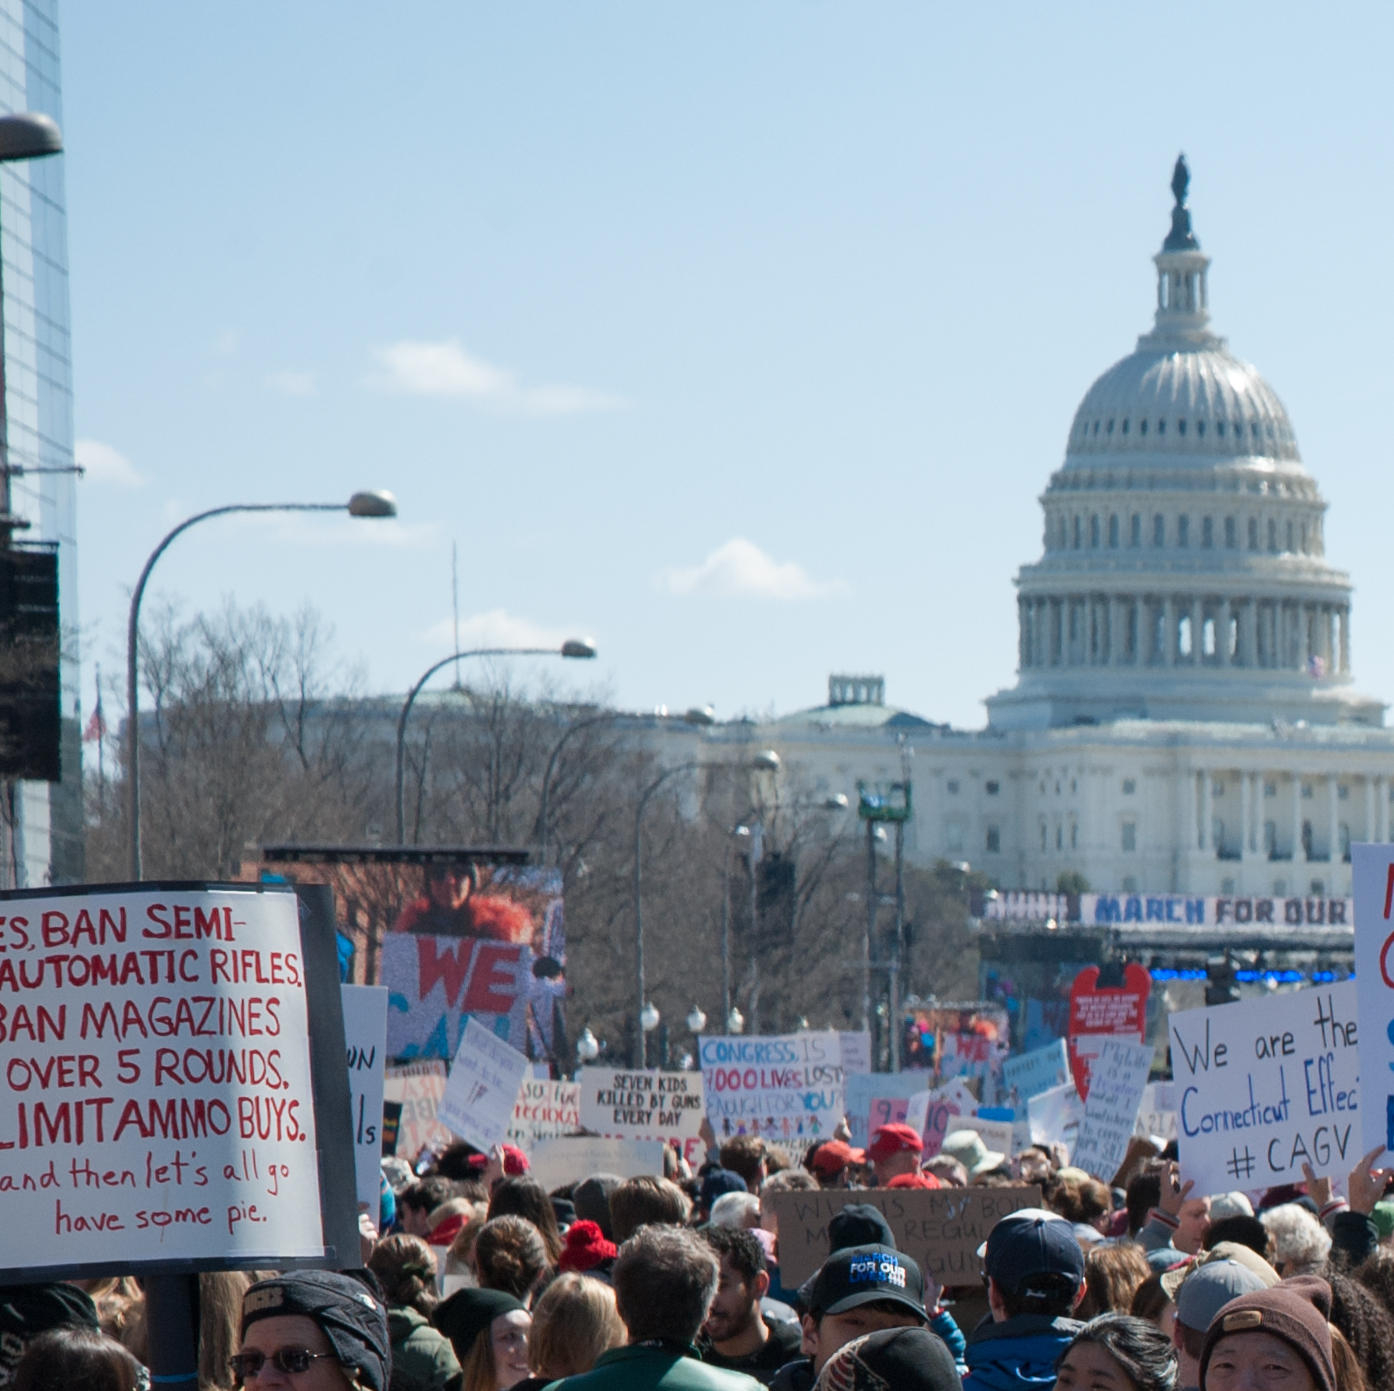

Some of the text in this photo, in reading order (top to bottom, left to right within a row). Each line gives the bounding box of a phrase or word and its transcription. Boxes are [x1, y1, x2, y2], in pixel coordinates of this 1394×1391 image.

[0, 904, 247, 951] ES, BAN SEMI-
[1094, 897, 1205, 923] MARCH
[1215, 898, 1274, 923] FOR
[1284, 898, 1346, 924] OUR
[0, 948, 302, 992] AUTOMATIC RIFLES.
[416, 936, 521, 1013] WE
[80, 997, 281, 1042] MAGAZINES
[1173, 993, 1358, 1075] We are the
[802, 1037, 826, 1062] IS
[7, 1047, 289, 1092] OVER 5 ROUNDS.
[613, 1074, 688, 1092] SEVEN KIDS
[760, 1067, 803, 1090] LIVES
[597, 1090, 645, 1107] KILLED
[649, 1092, 664, 1107] BY
[671, 1094, 702, 1109] GUNS
[1181, 1064, 1291, 1138] Connecticut
[1303, 1051, 1360, 1117] Effec
[113, 1097, 231, 1141] AMMO
[238, 1095, 306, 1142] BUYS.
[613, 1108, 683, 1126] EVERY DAY
[0, 1147, 289, 1197] and then let's all go
[55, 1199, 267, 1236] have some pie.
[849, 1262, 906, 1275] FOR OUR
[849, 1270, 886, 1283] LIVES
[852, 1252, 899, 1265] MARCH
